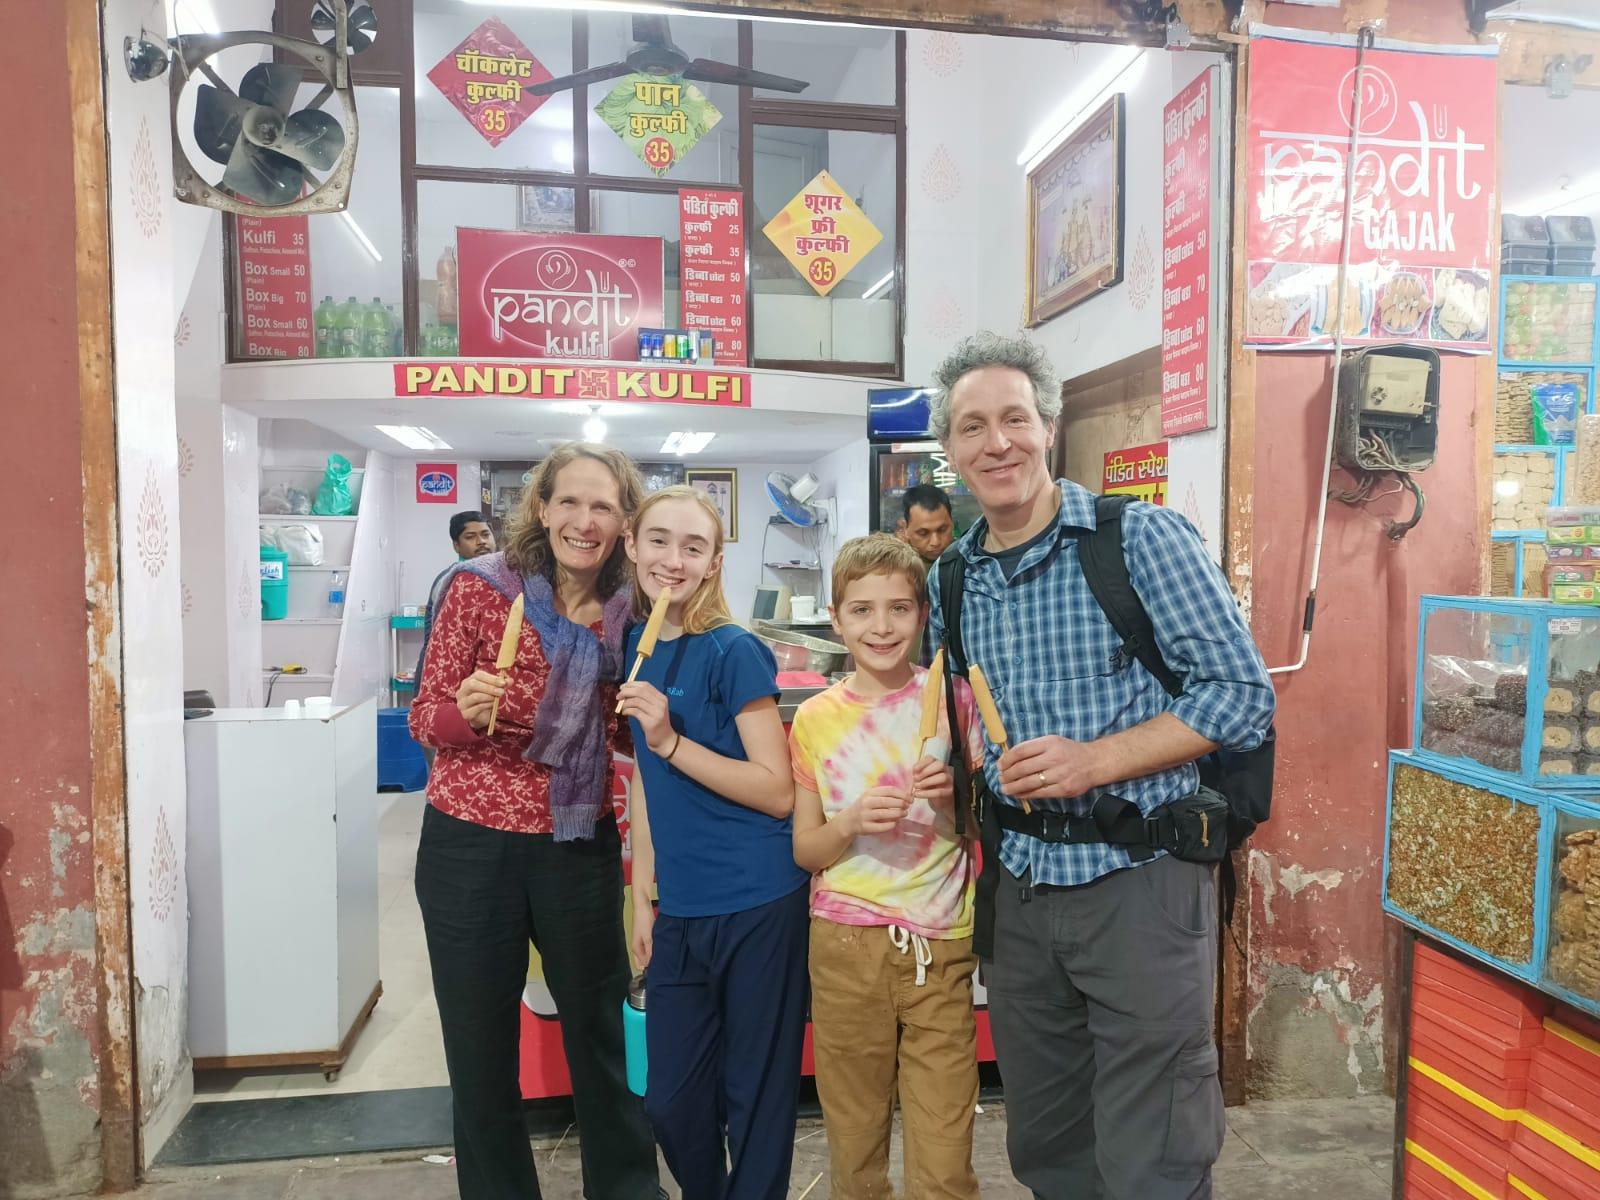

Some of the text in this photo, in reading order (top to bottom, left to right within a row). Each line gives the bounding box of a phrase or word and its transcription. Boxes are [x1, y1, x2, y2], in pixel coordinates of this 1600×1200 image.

[456, 49, 533, 77] चॉकलेट
[466, 79, 522, 105] कुल्फी
[634, 82, 681, 107] पान
[629, 110, 688, 138] कुल्फी
[683, 195, 739, 219] पंडित कुल्फी
[804, 194, 843, 214] शूगर
[684, 220, 739, 234] कुल्फी 25
[810, 216, 837, 235] फ्री
[1363, 209, 1456, 252] GAJAK
[243, 229, 304, 245] Kulfi 35
[796, 235, 850, 256] कुल्फी
[1197, 230, 1206, 250] 50
[684, 243, 740, 257] कुल्फी 35
[245, 261, 268, 275] Box
[294, 264, 305, 276] 50
[730, 272, 741, 282] 50
[1196, 274, 1205, 295] 70
[246, 288, 306, 304] Box Big 70
[491, 269, 633, 340] pandit
[730, 294, 741, 305] 70
[247, 314, 308, 329] Box Small 60
[731, 316, 741, 327] 60
[1196, 316, 1205, 337] 60
[249, 343, 272, 356] Box
[298, 345, 309, 357] 80
[545, 329, 610, 358] kulfi
[731, 340, 742, 350] 80
[1196, 362, 1204, 382] 80
[406, 366, 743, 401] PANDIT KULFI
[1105, 450, 1168, 483] पंडित स्पेश
